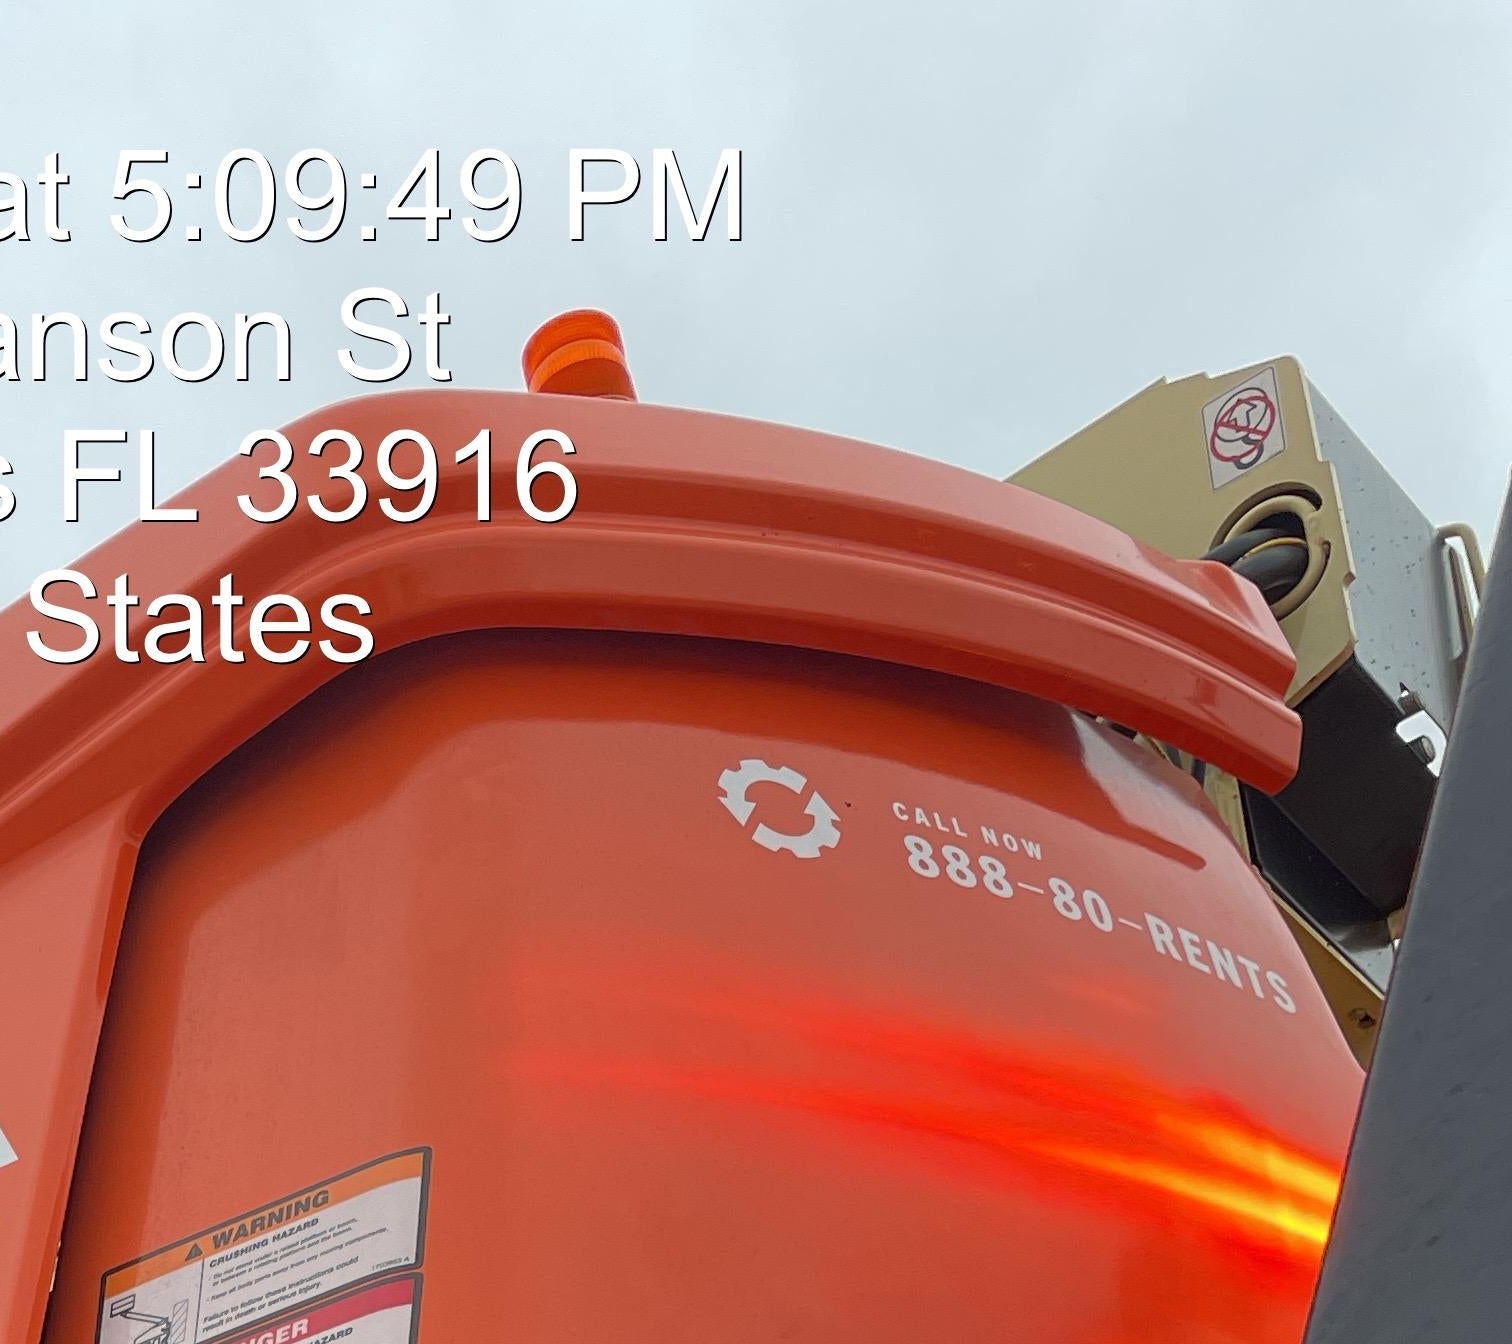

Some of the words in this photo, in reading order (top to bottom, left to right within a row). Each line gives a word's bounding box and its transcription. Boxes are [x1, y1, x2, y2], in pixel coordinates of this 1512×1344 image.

[892, 801, 968, 838] CALL
[981, 825, 1043, 862] NOW
[904, 834, 1297, 1014] 888-80-RENTS
[209, 1238, 268, 1268] CRUSHING
[272, 1217, 318, 1242] HAZARD
[211, 1189, 330, 1250] WARNING
